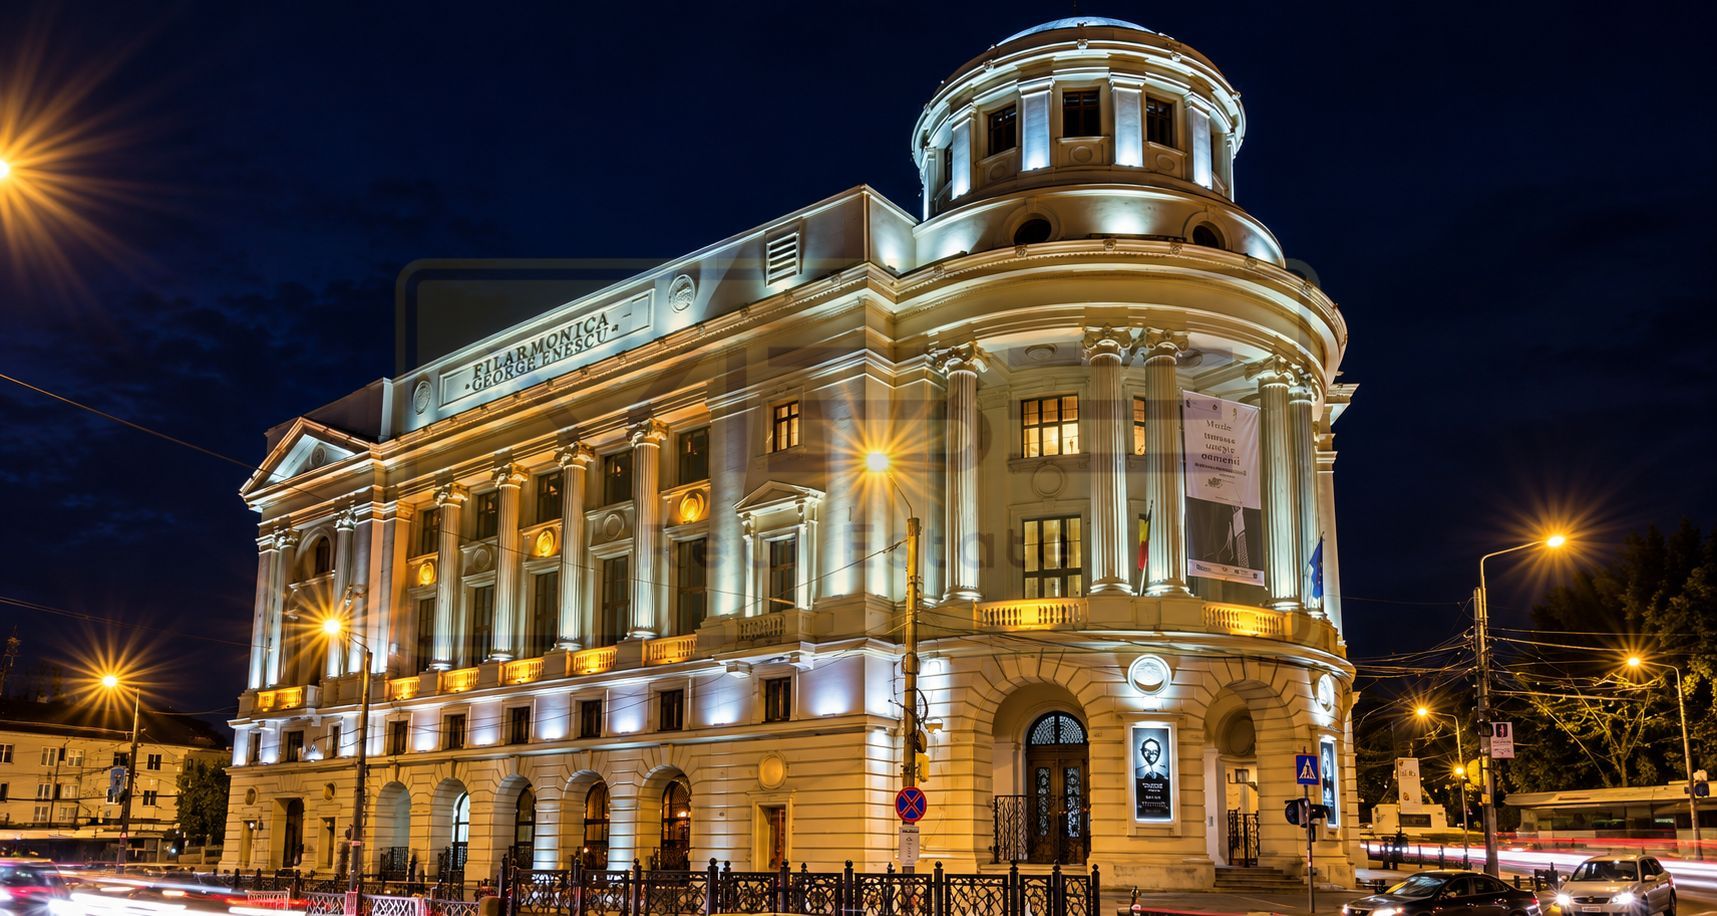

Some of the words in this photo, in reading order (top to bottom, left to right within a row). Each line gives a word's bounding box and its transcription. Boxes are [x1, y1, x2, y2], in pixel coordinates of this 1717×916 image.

[472, 312, 609, 379] FILARMONICA
[472, 357, 537, 391] GEORGE
[542, 326, 609, 366] ENESCU
[1201, 453, 1240, 466] oamenii
